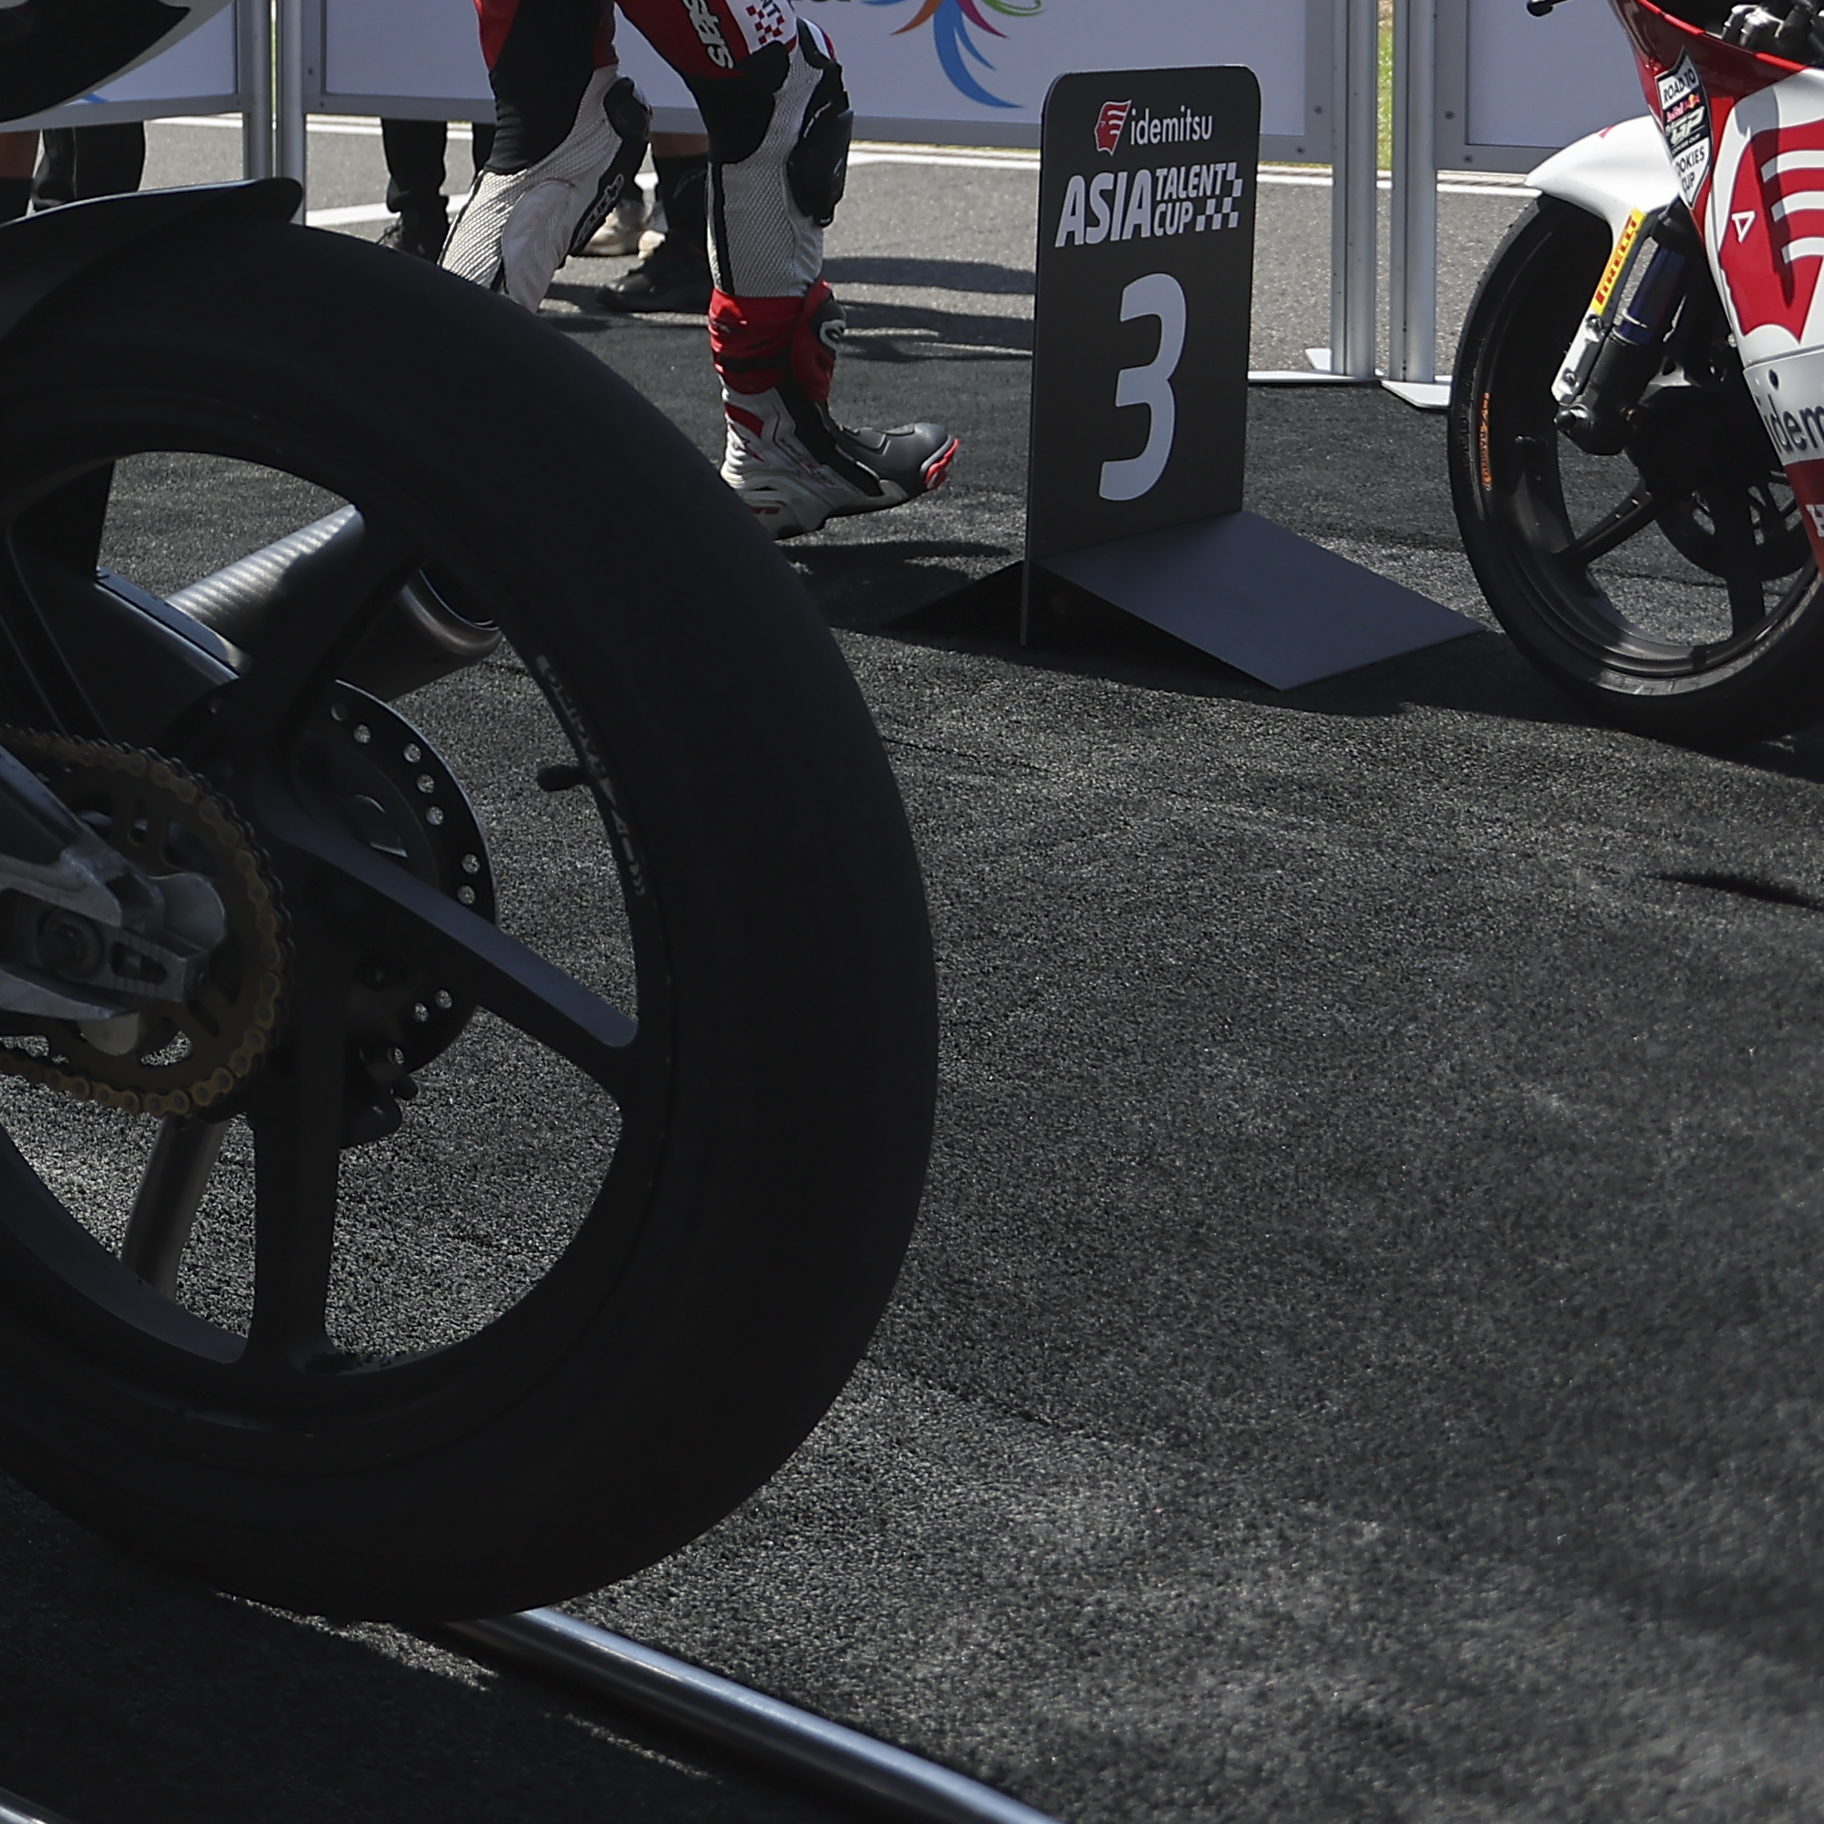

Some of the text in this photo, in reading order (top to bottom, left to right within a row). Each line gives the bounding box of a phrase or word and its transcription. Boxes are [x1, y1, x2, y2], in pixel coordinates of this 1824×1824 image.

[1662, 68, 1696, 103] ROAD TO
[1130, 104, 1214, 146] idemitsu
[1155, 162, 1227, 202] TALENT
[1055, 168, 1152, 248] ASIA
[1154, 200, 1195, 237] CUP
[1594, 213, 1638, 307] PIRELLI
[1099, 272, 1187, 501] 3
